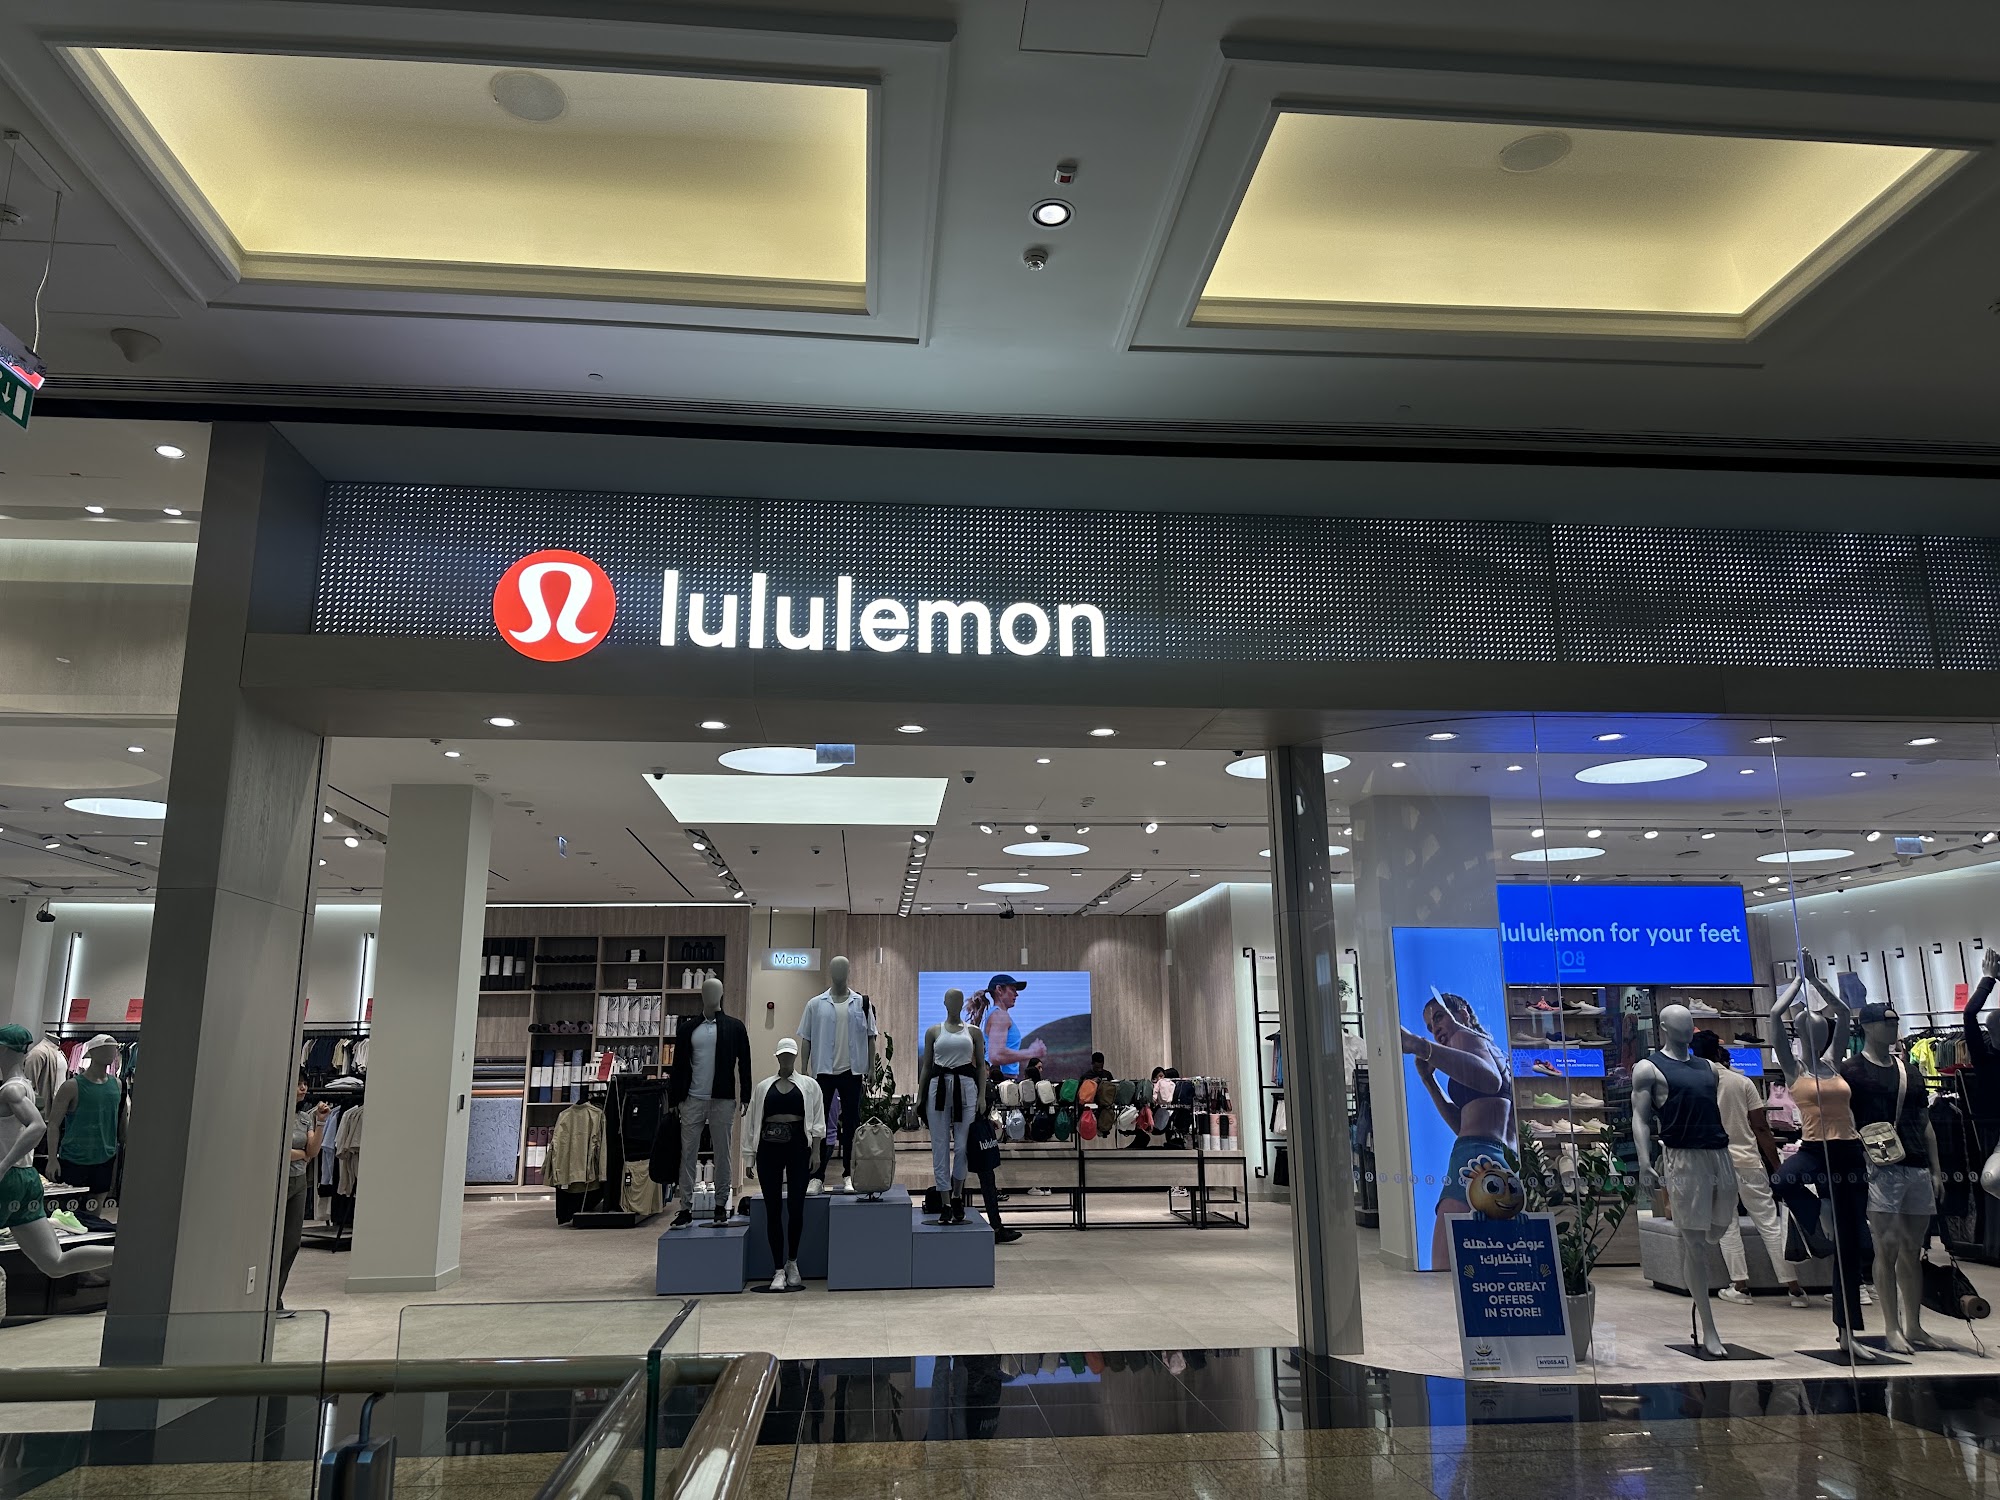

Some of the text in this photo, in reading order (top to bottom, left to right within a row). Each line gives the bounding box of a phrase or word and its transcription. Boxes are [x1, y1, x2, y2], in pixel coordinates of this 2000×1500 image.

[659, 569, 1106, 658] lululemon
[1501, 922, 1742, 947] lululemon for your feet
[774, 953, 808, 965] Mens
[1463, 1237, 1545, 1251] عروض مذهلة
[1480, 1253, 1532, 1267] بانتظارك!
[1472, 1281, 1547, 1292] SHOP GREAT
[1489, 1294, 1534, 1305] OFFERS
[1485, 1307, 1542, 1318] IN STORE!
